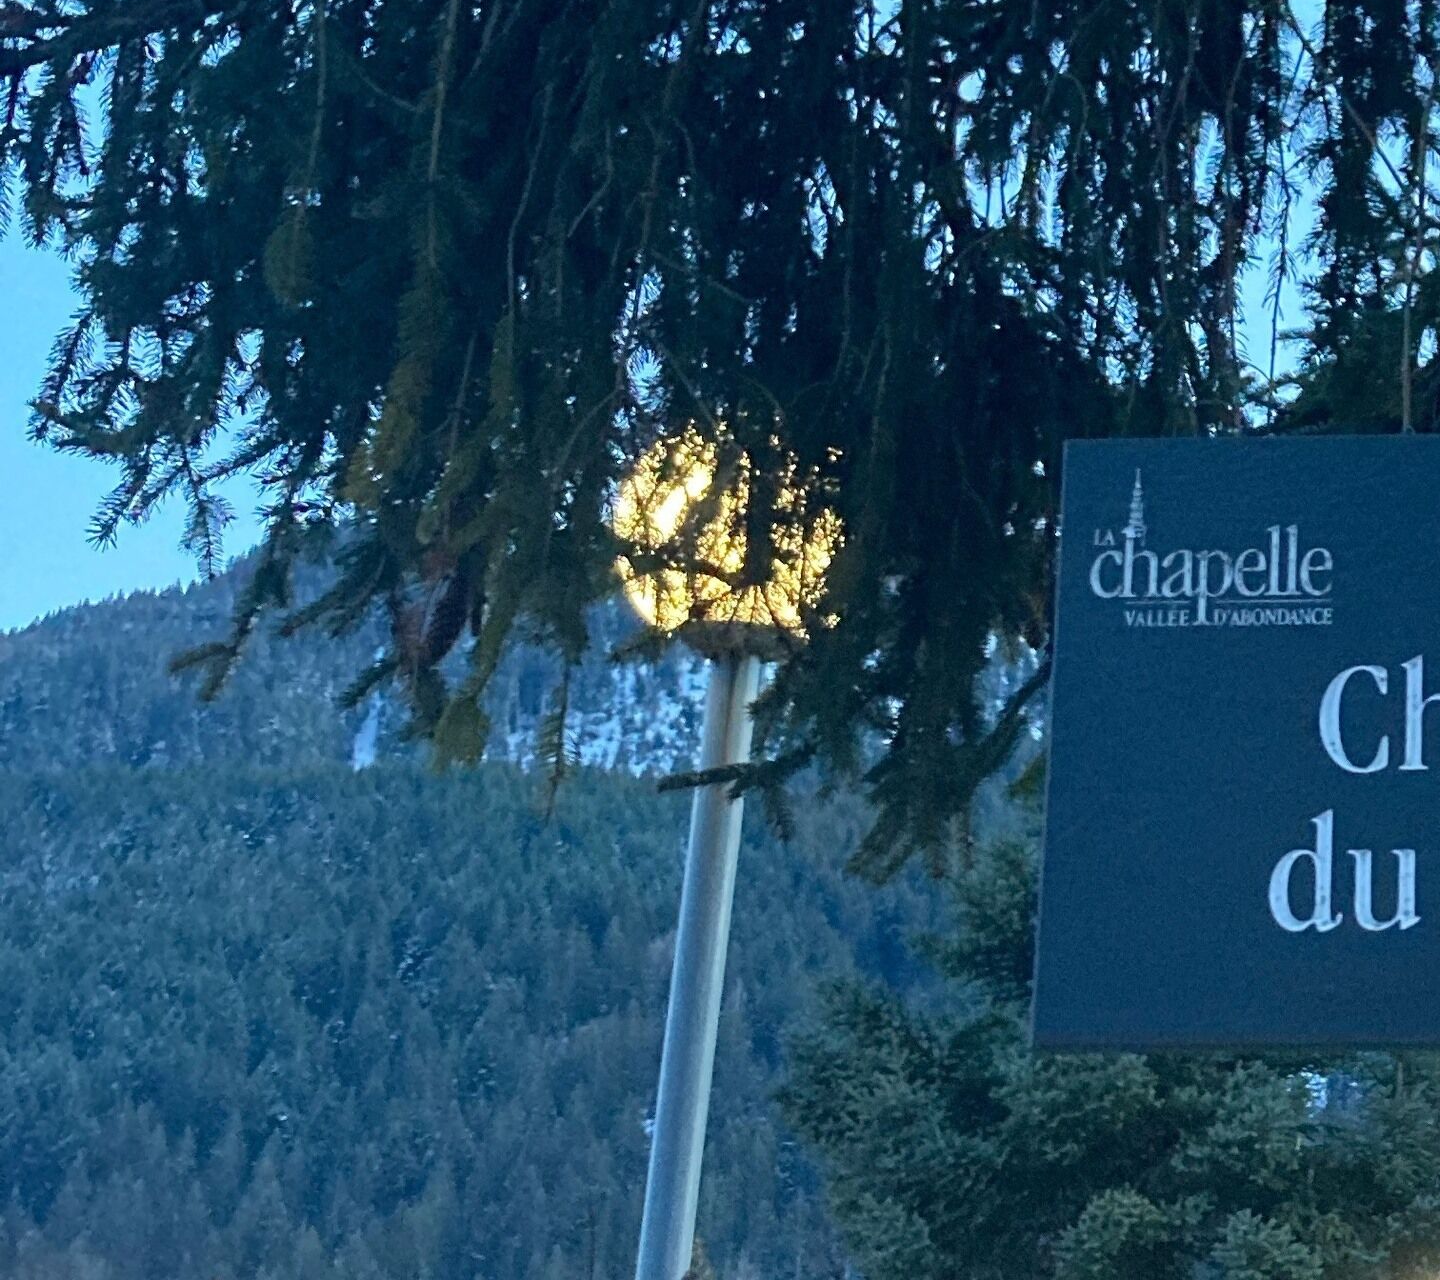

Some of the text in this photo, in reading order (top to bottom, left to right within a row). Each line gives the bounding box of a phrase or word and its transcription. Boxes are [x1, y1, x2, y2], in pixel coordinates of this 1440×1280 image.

[1094, 528, 1116, 546] LA
[1089, 523, 1334, 626] chapelle
[1213, 607, 1334, 626] D'ABONDANCE
[1268, 809, 1421, 933] du
